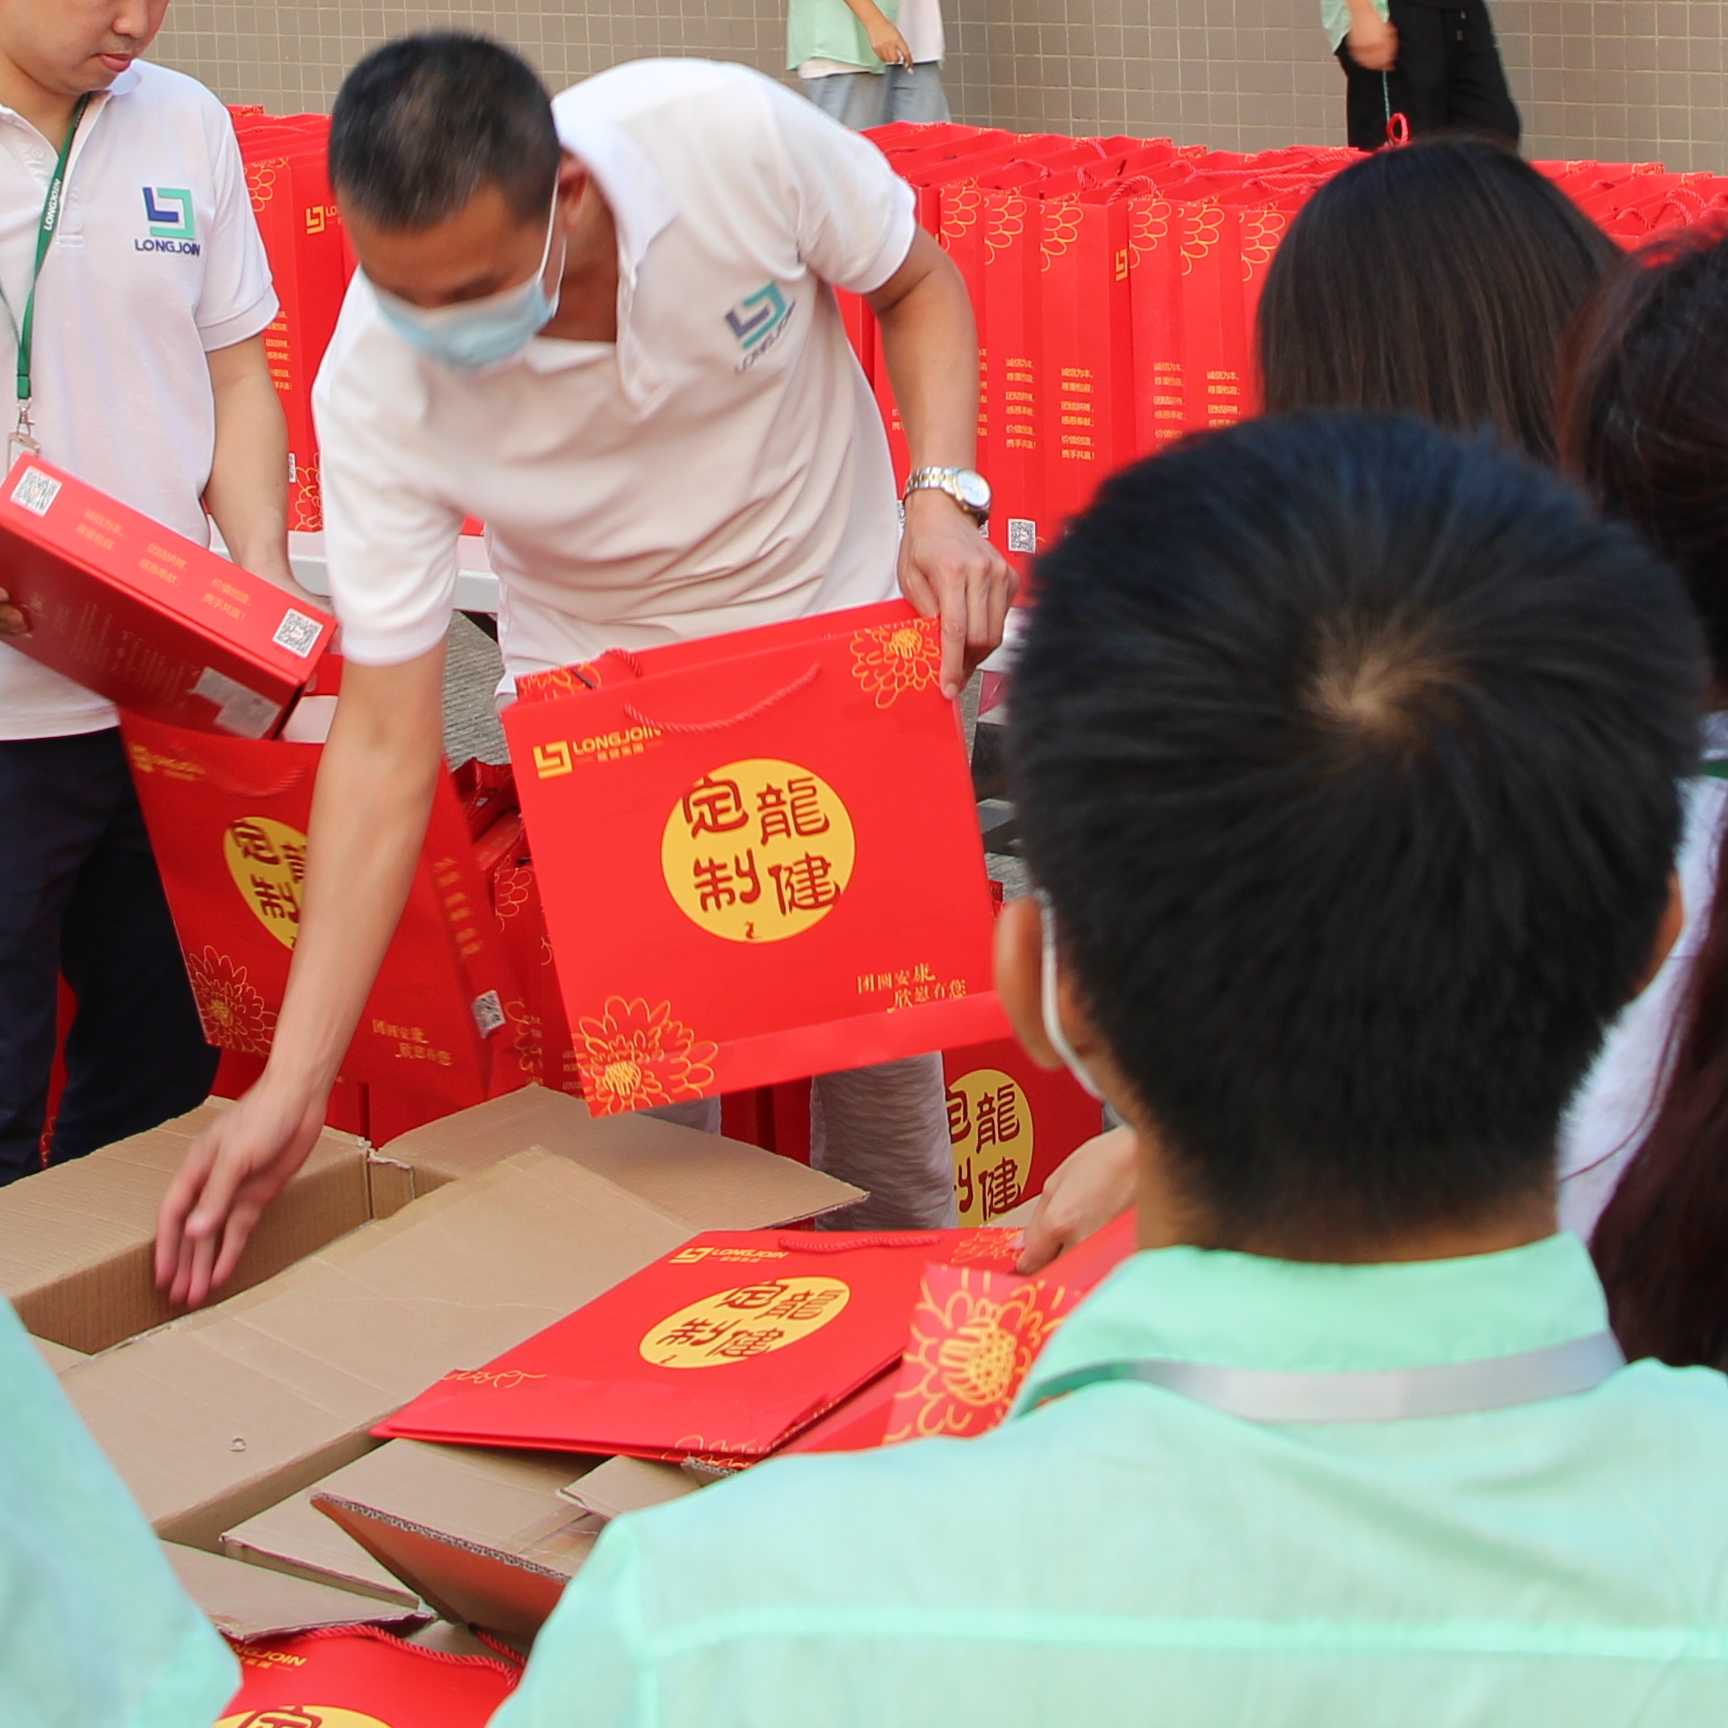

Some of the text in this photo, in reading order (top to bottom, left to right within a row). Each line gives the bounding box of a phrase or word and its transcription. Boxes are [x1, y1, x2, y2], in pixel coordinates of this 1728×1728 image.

[134, 239, 201, 257] LONGJOIN
[711, 1248, 788, 1259] LONGJOIN
[231, 1643, 307, 1667] NGJOIN
